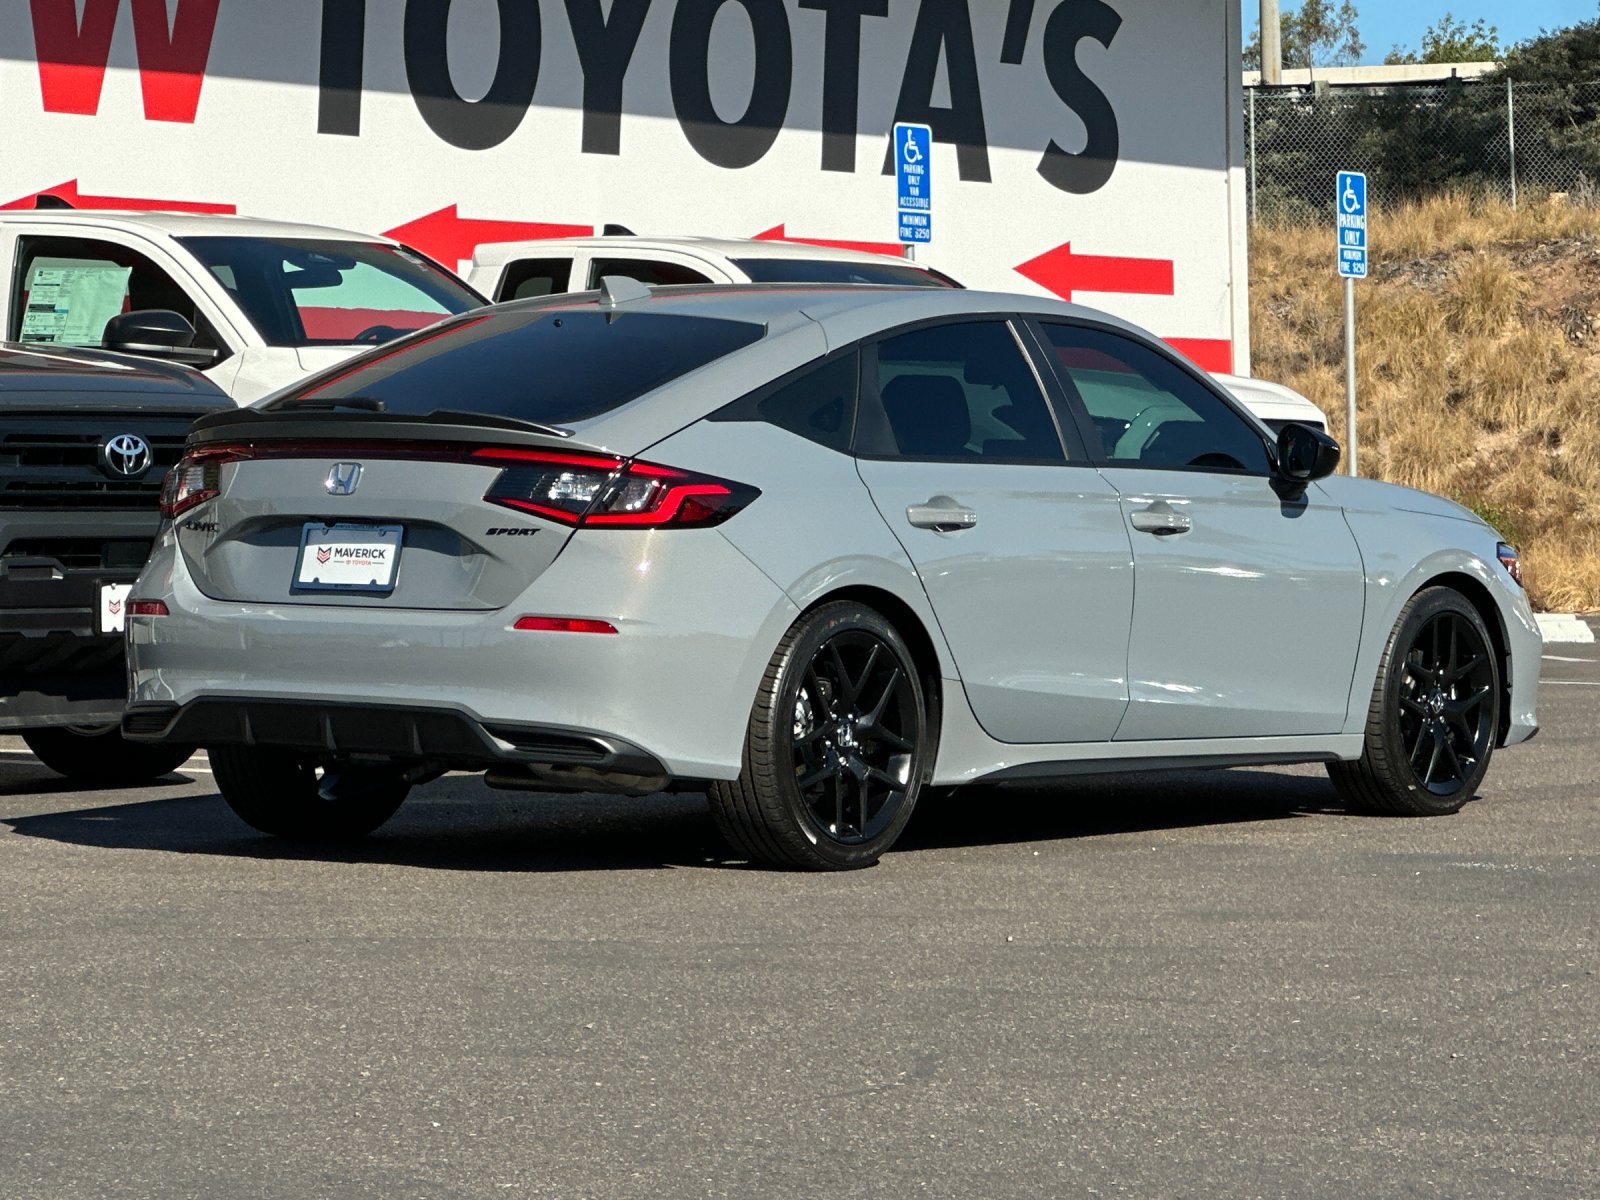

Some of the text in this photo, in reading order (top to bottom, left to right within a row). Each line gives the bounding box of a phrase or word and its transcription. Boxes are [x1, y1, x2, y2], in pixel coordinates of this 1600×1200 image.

[904, 164, 924, 174] PARKING
[908, 175, 920, 185] ONLY
[909, 186, 919, 196] VAN
[900, 196, 929, 208] ACCESSIBLE
[902, 215, 927, 226] MINIMUM
[1340, 213, 1364, 230] PARKING
[900, 227, 930, 239] FINE $250
[1344, 229, 1361, 245] ONLY
[484, 527, 542, 536] SPORT
[334, 547, 387, 560] MAVERICK
